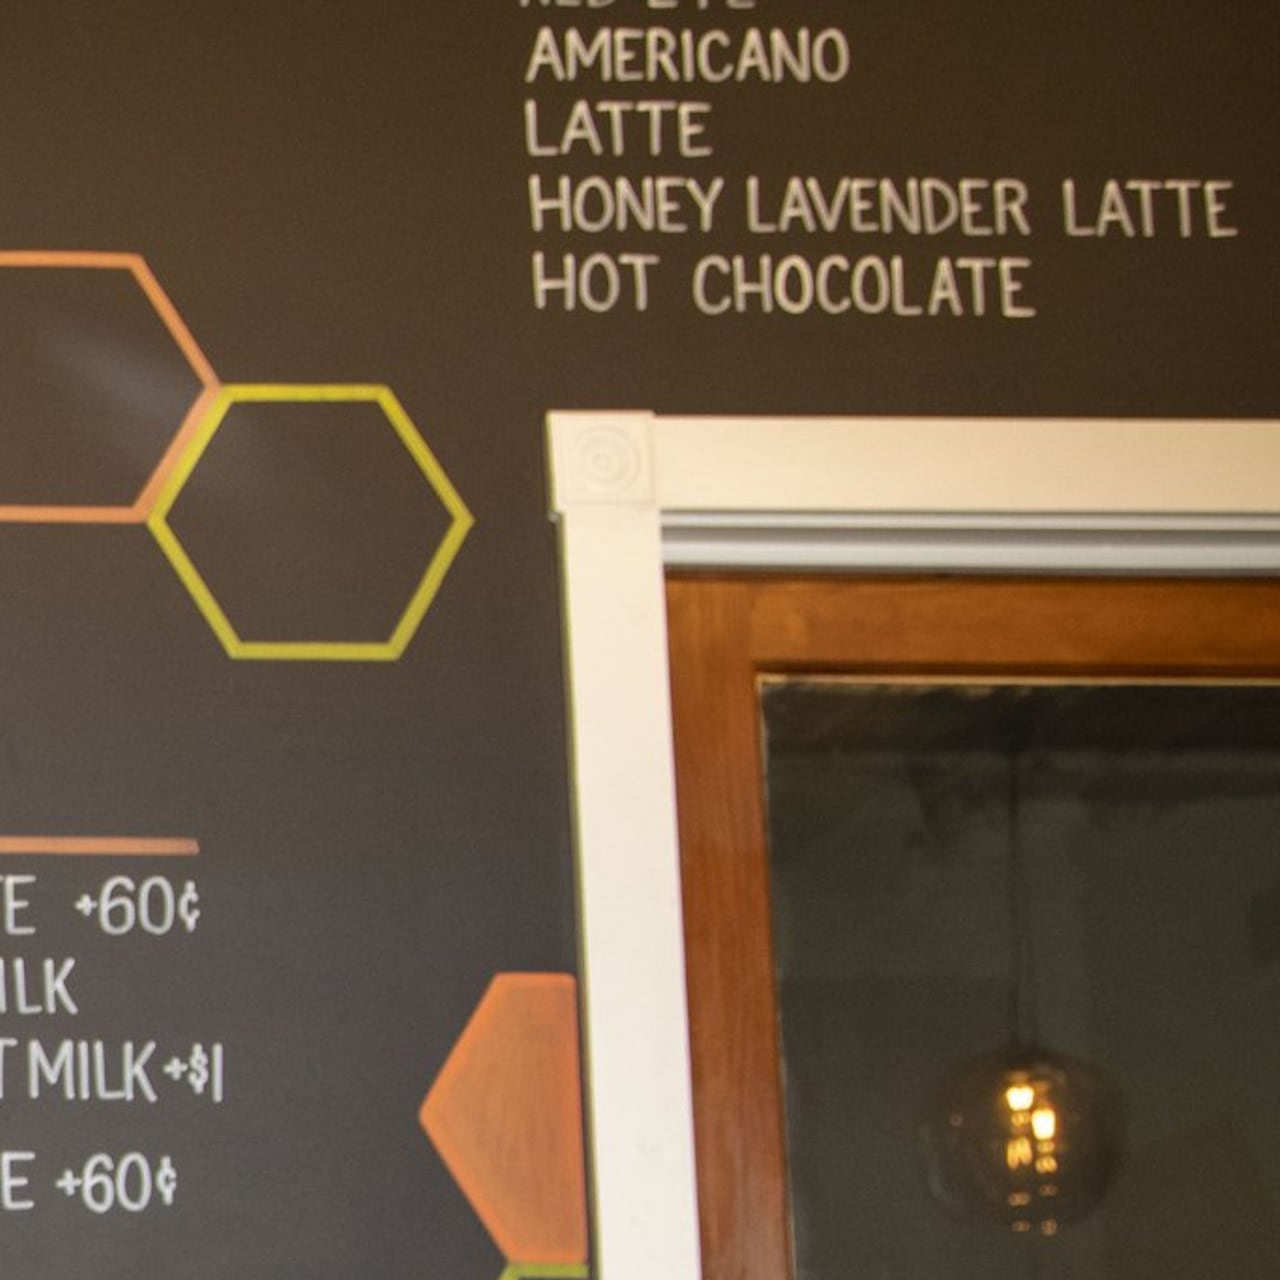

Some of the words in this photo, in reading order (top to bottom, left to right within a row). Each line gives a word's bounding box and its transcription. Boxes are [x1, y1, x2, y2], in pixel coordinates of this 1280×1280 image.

[525, 26, 849, 83] AMERICANO
[524, 99, 711, 157] LATTE
[528, 174, 724, 233] HONEY
[746, 175, 1030, 236] LAVENDER
[1062, 178, 1237, 238] LATTE
[532, 251, 659, 312] HOT
[693, 254, 1035, 318] CHOCOLATE
[28, 1039, 158, 1103] MILK
